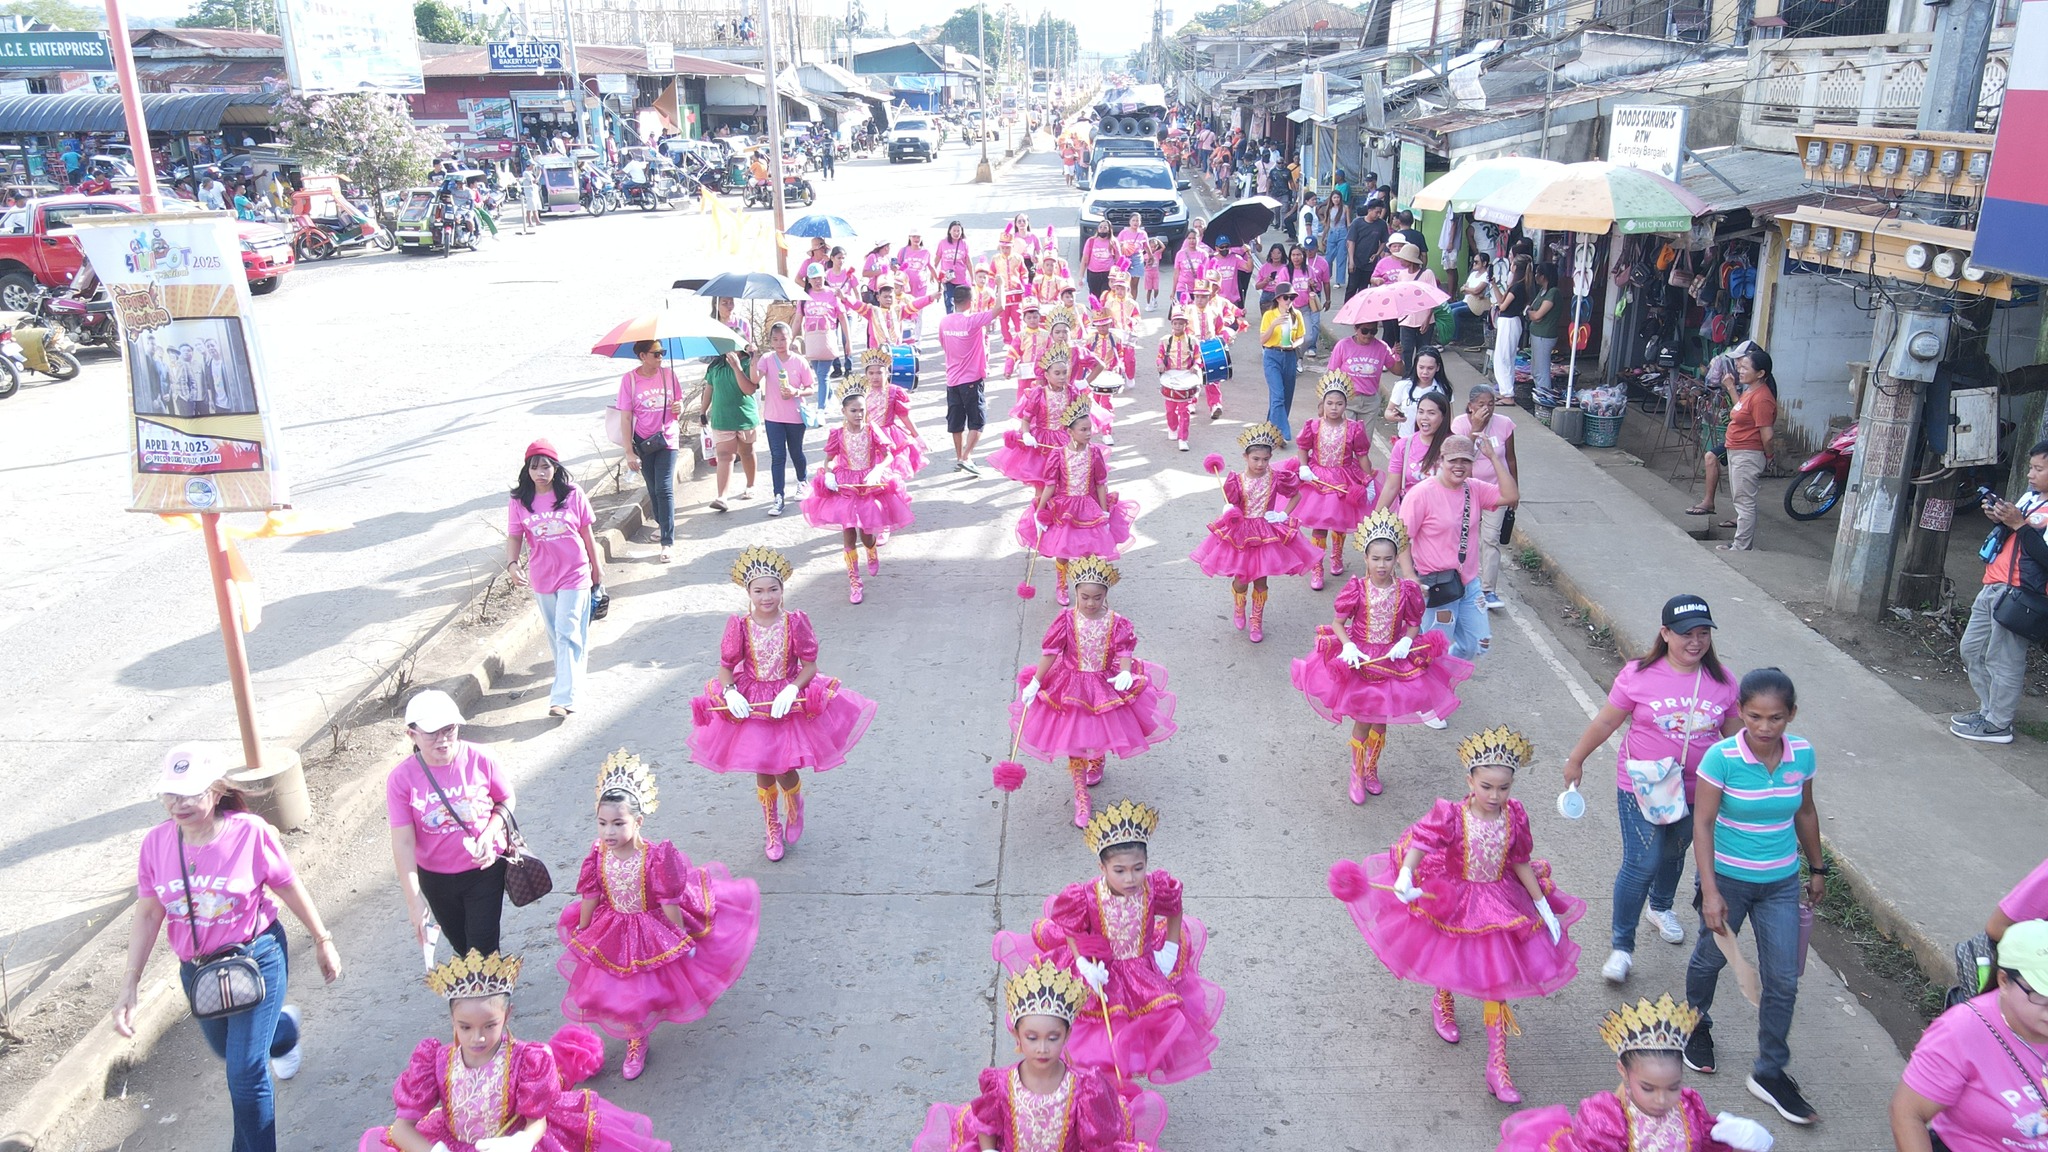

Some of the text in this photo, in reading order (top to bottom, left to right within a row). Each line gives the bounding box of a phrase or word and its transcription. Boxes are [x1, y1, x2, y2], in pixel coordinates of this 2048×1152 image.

[29, 42, 104, 57] ENTERPRISES
[492, 44, 558, 59] J&C BELUSO
[1616, 109, 1677, 129] DOODS SAKURA'S
[1634, 129, 1651, 143] RTW
[1617, 143, 1668, 160] Everyday Bargain!
[1638, 220, 1684, 229] MICROMATIC
[193, 256, 221, 268] 2025
[145, 438, 168, 451] APRIL
[185, 440, 209, 453] 2025
[200, 455, 220, 464] PLAZA!
[1649, 697, 1724, 715] PRWES
